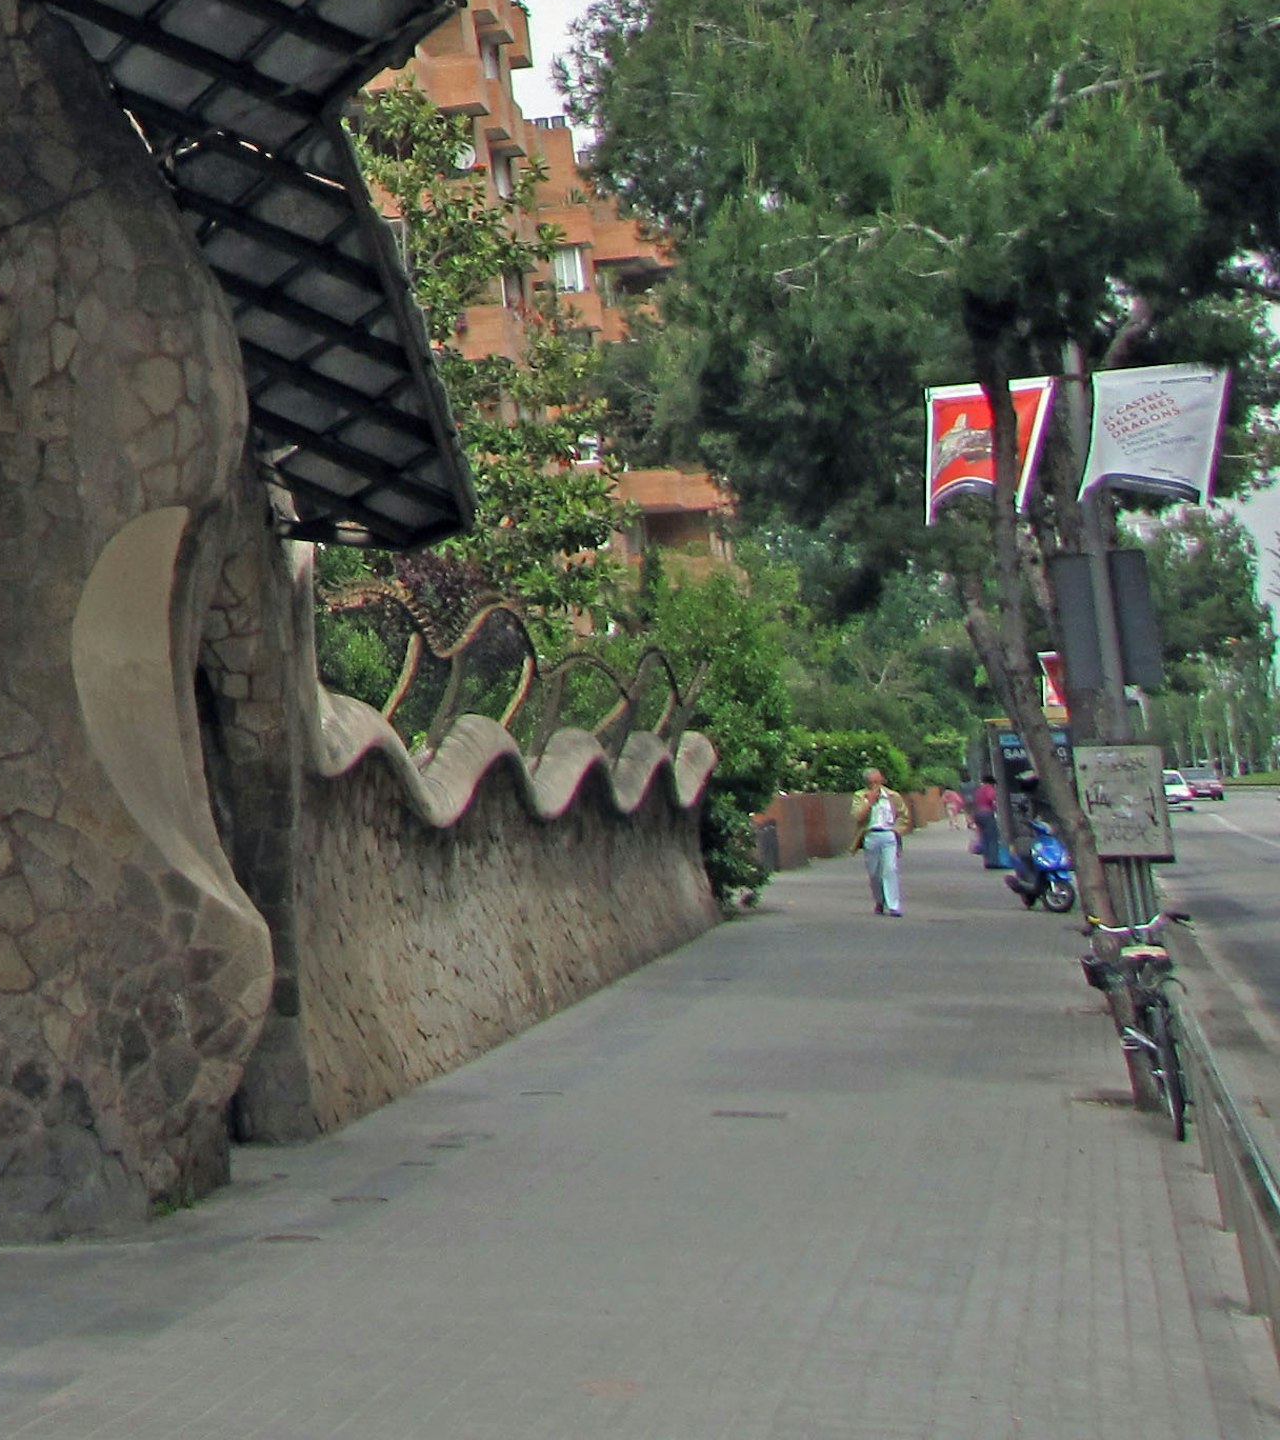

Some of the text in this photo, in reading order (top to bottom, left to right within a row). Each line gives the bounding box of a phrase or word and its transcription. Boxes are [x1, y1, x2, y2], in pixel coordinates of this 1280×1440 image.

[1106, 397, 1175, 433] DELS TRES
[1116, 390, 1168, 415] CASTELL
[1111, 405, 1181, 439] DRAGONS
